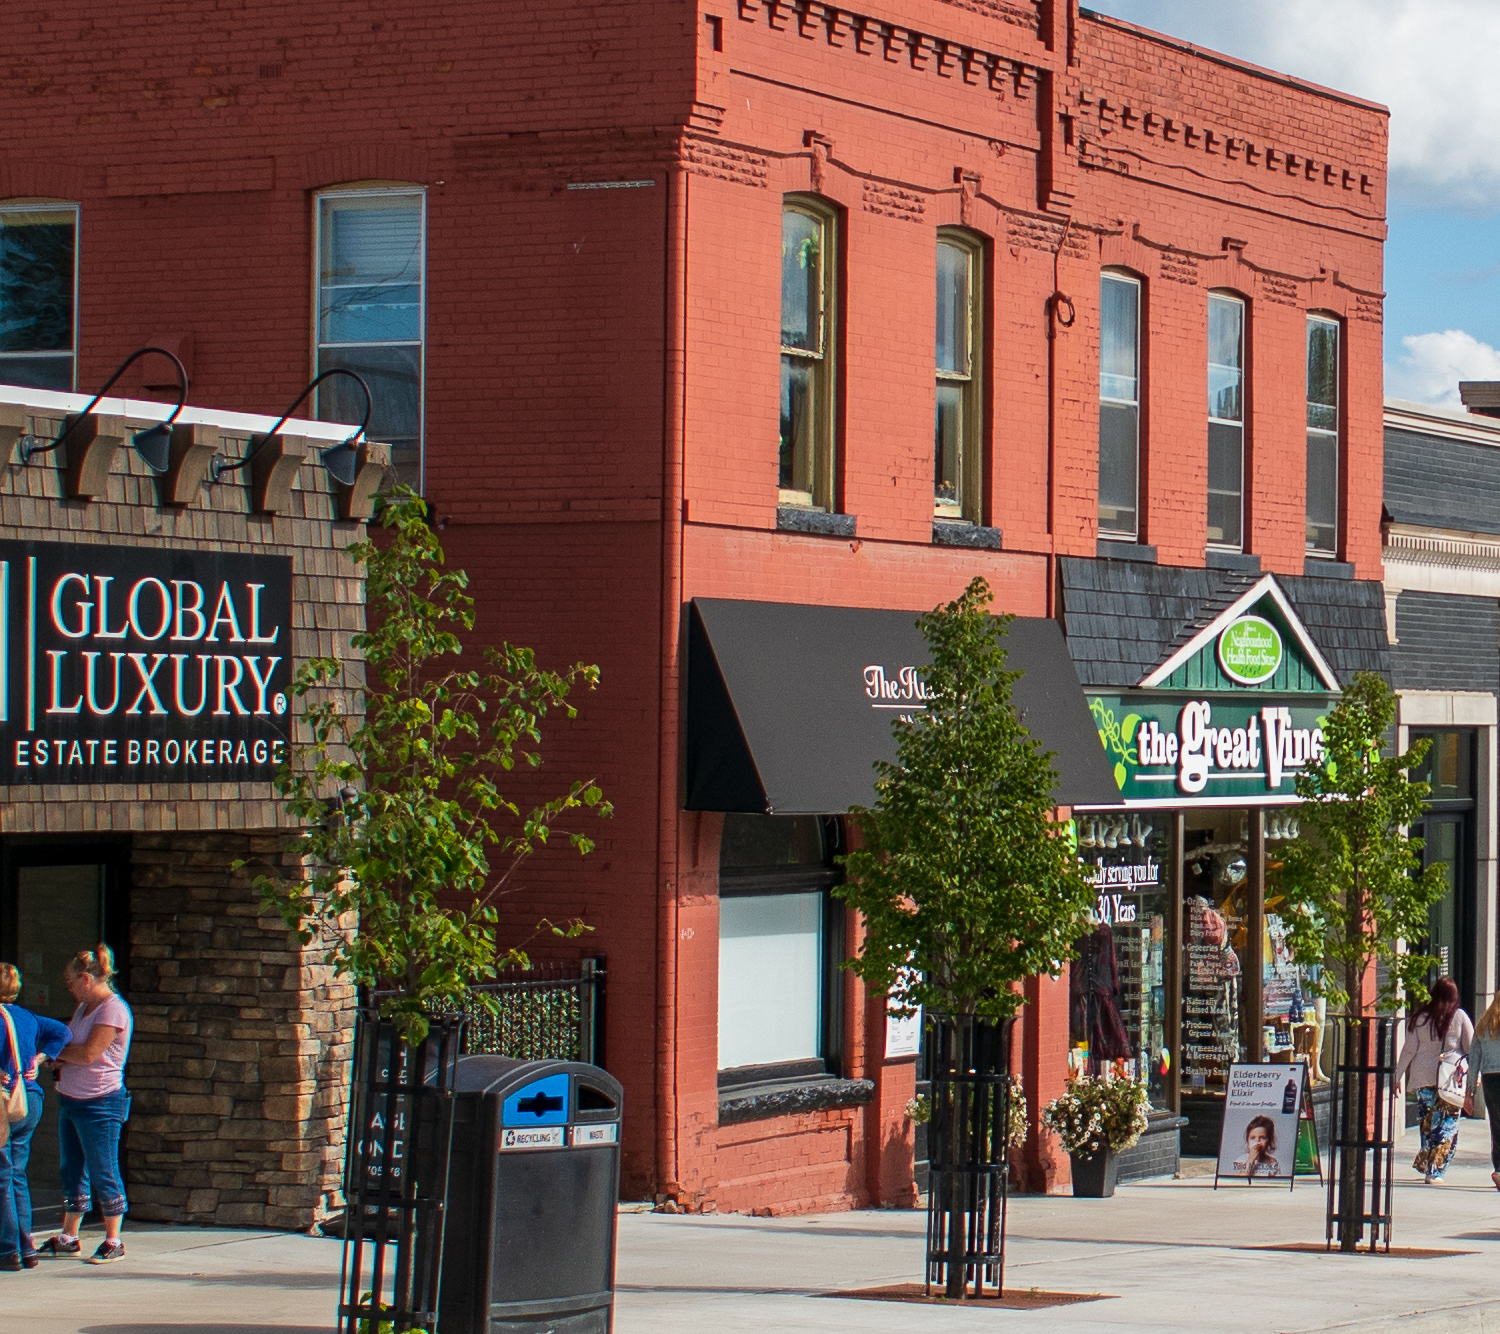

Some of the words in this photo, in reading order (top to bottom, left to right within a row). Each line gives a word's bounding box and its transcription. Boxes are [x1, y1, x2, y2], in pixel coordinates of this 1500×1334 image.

[50, 572, 279, 644] GLOBAL
[1230, 629, 1273, 651] Neighbourhood
[1226, 648, 1246, 665] Health
[1246, 648, 1261, 665] Food
[45, 649, 283, 716] LUXURY
[863, 665, 900, 699] The
[14, 739, 118, 766] ESTATE
[126, 739, 285, 765] BROKERAGE
[1138, 721, 1179, 766] the
[1261, 706, 1325, 788] Vine
[1107, 856, 1133, 890] serving
[1133, 865, 1146, 892] you
[1146, 855, 1159, 881] for
[1097, 894, 1111, 924] 30
[1111, 893, 1136, 923] Years
[1232, 1079, 1273, 1088] Wellness
[1233, 1071, 1282, 1080] Elderberry
[1231, 1088, 1255, 1097] Elixir
[516, 1133, 551, 1143] RECYCLING
